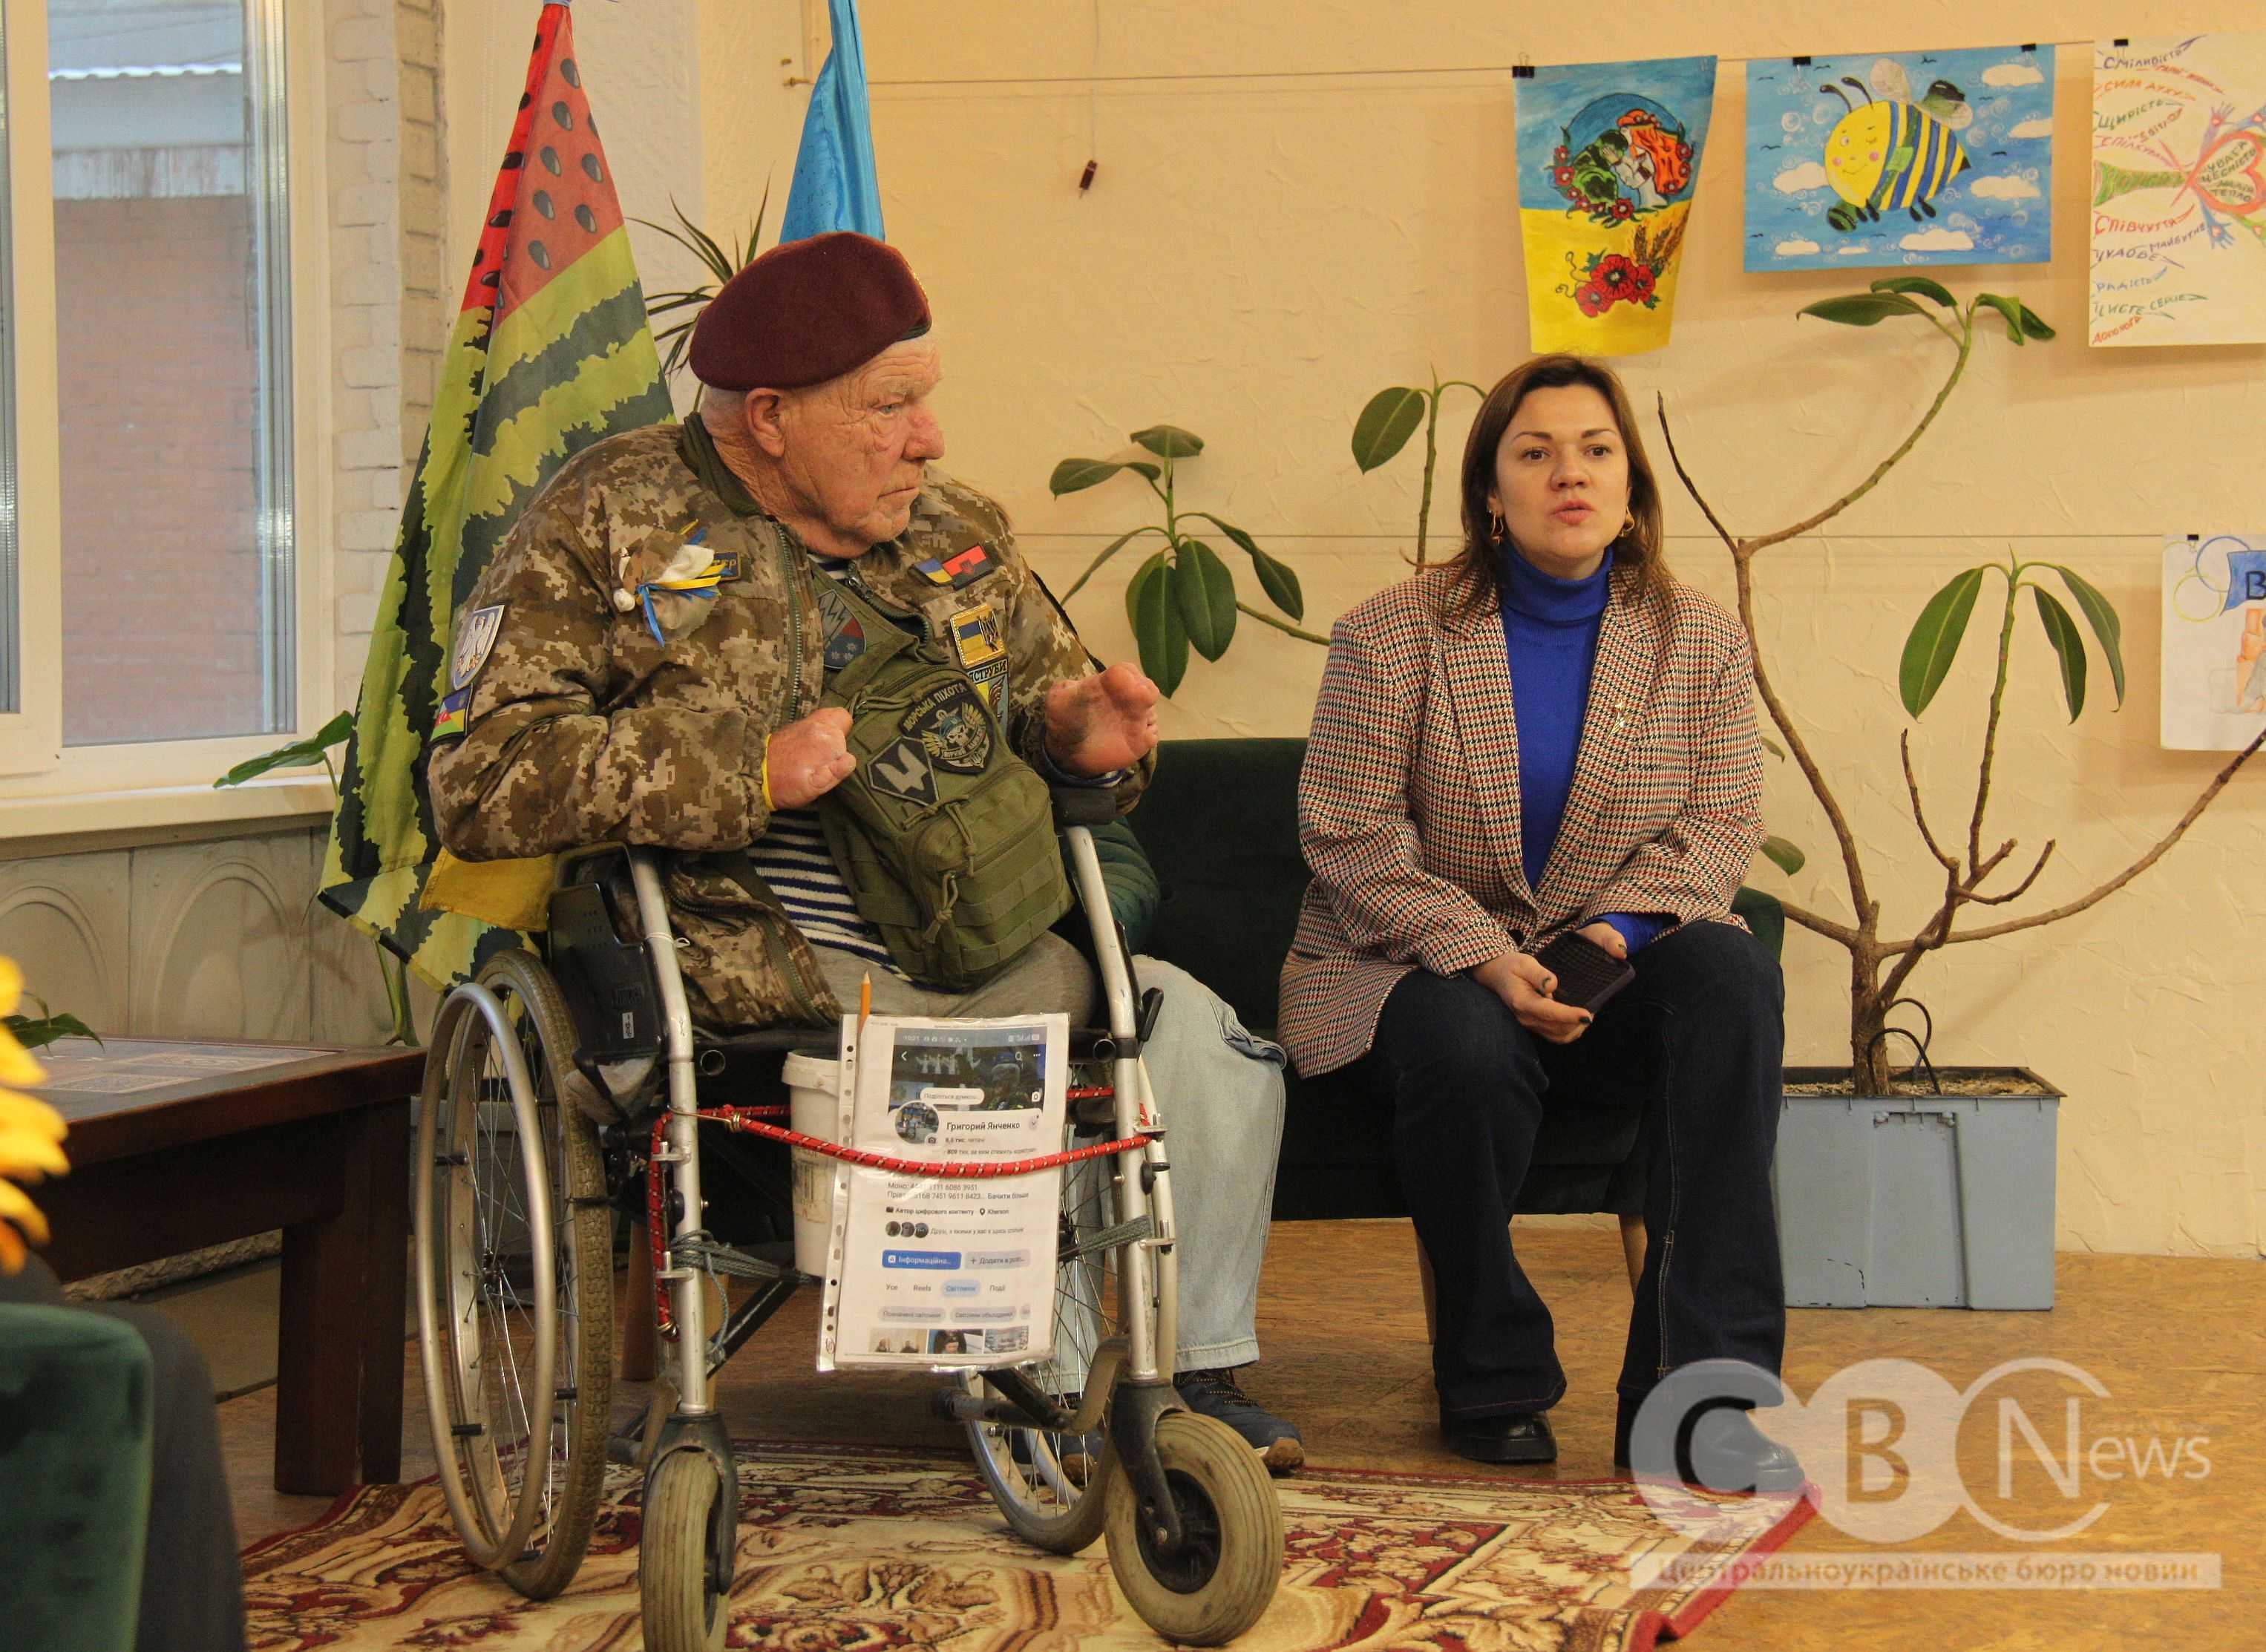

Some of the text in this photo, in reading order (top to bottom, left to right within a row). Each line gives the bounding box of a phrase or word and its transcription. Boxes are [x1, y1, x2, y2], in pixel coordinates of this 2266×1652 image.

[933, 682, 967, 704] ПІХОТА
[946, 1121, 1021, 1131] Григорий Янченко
